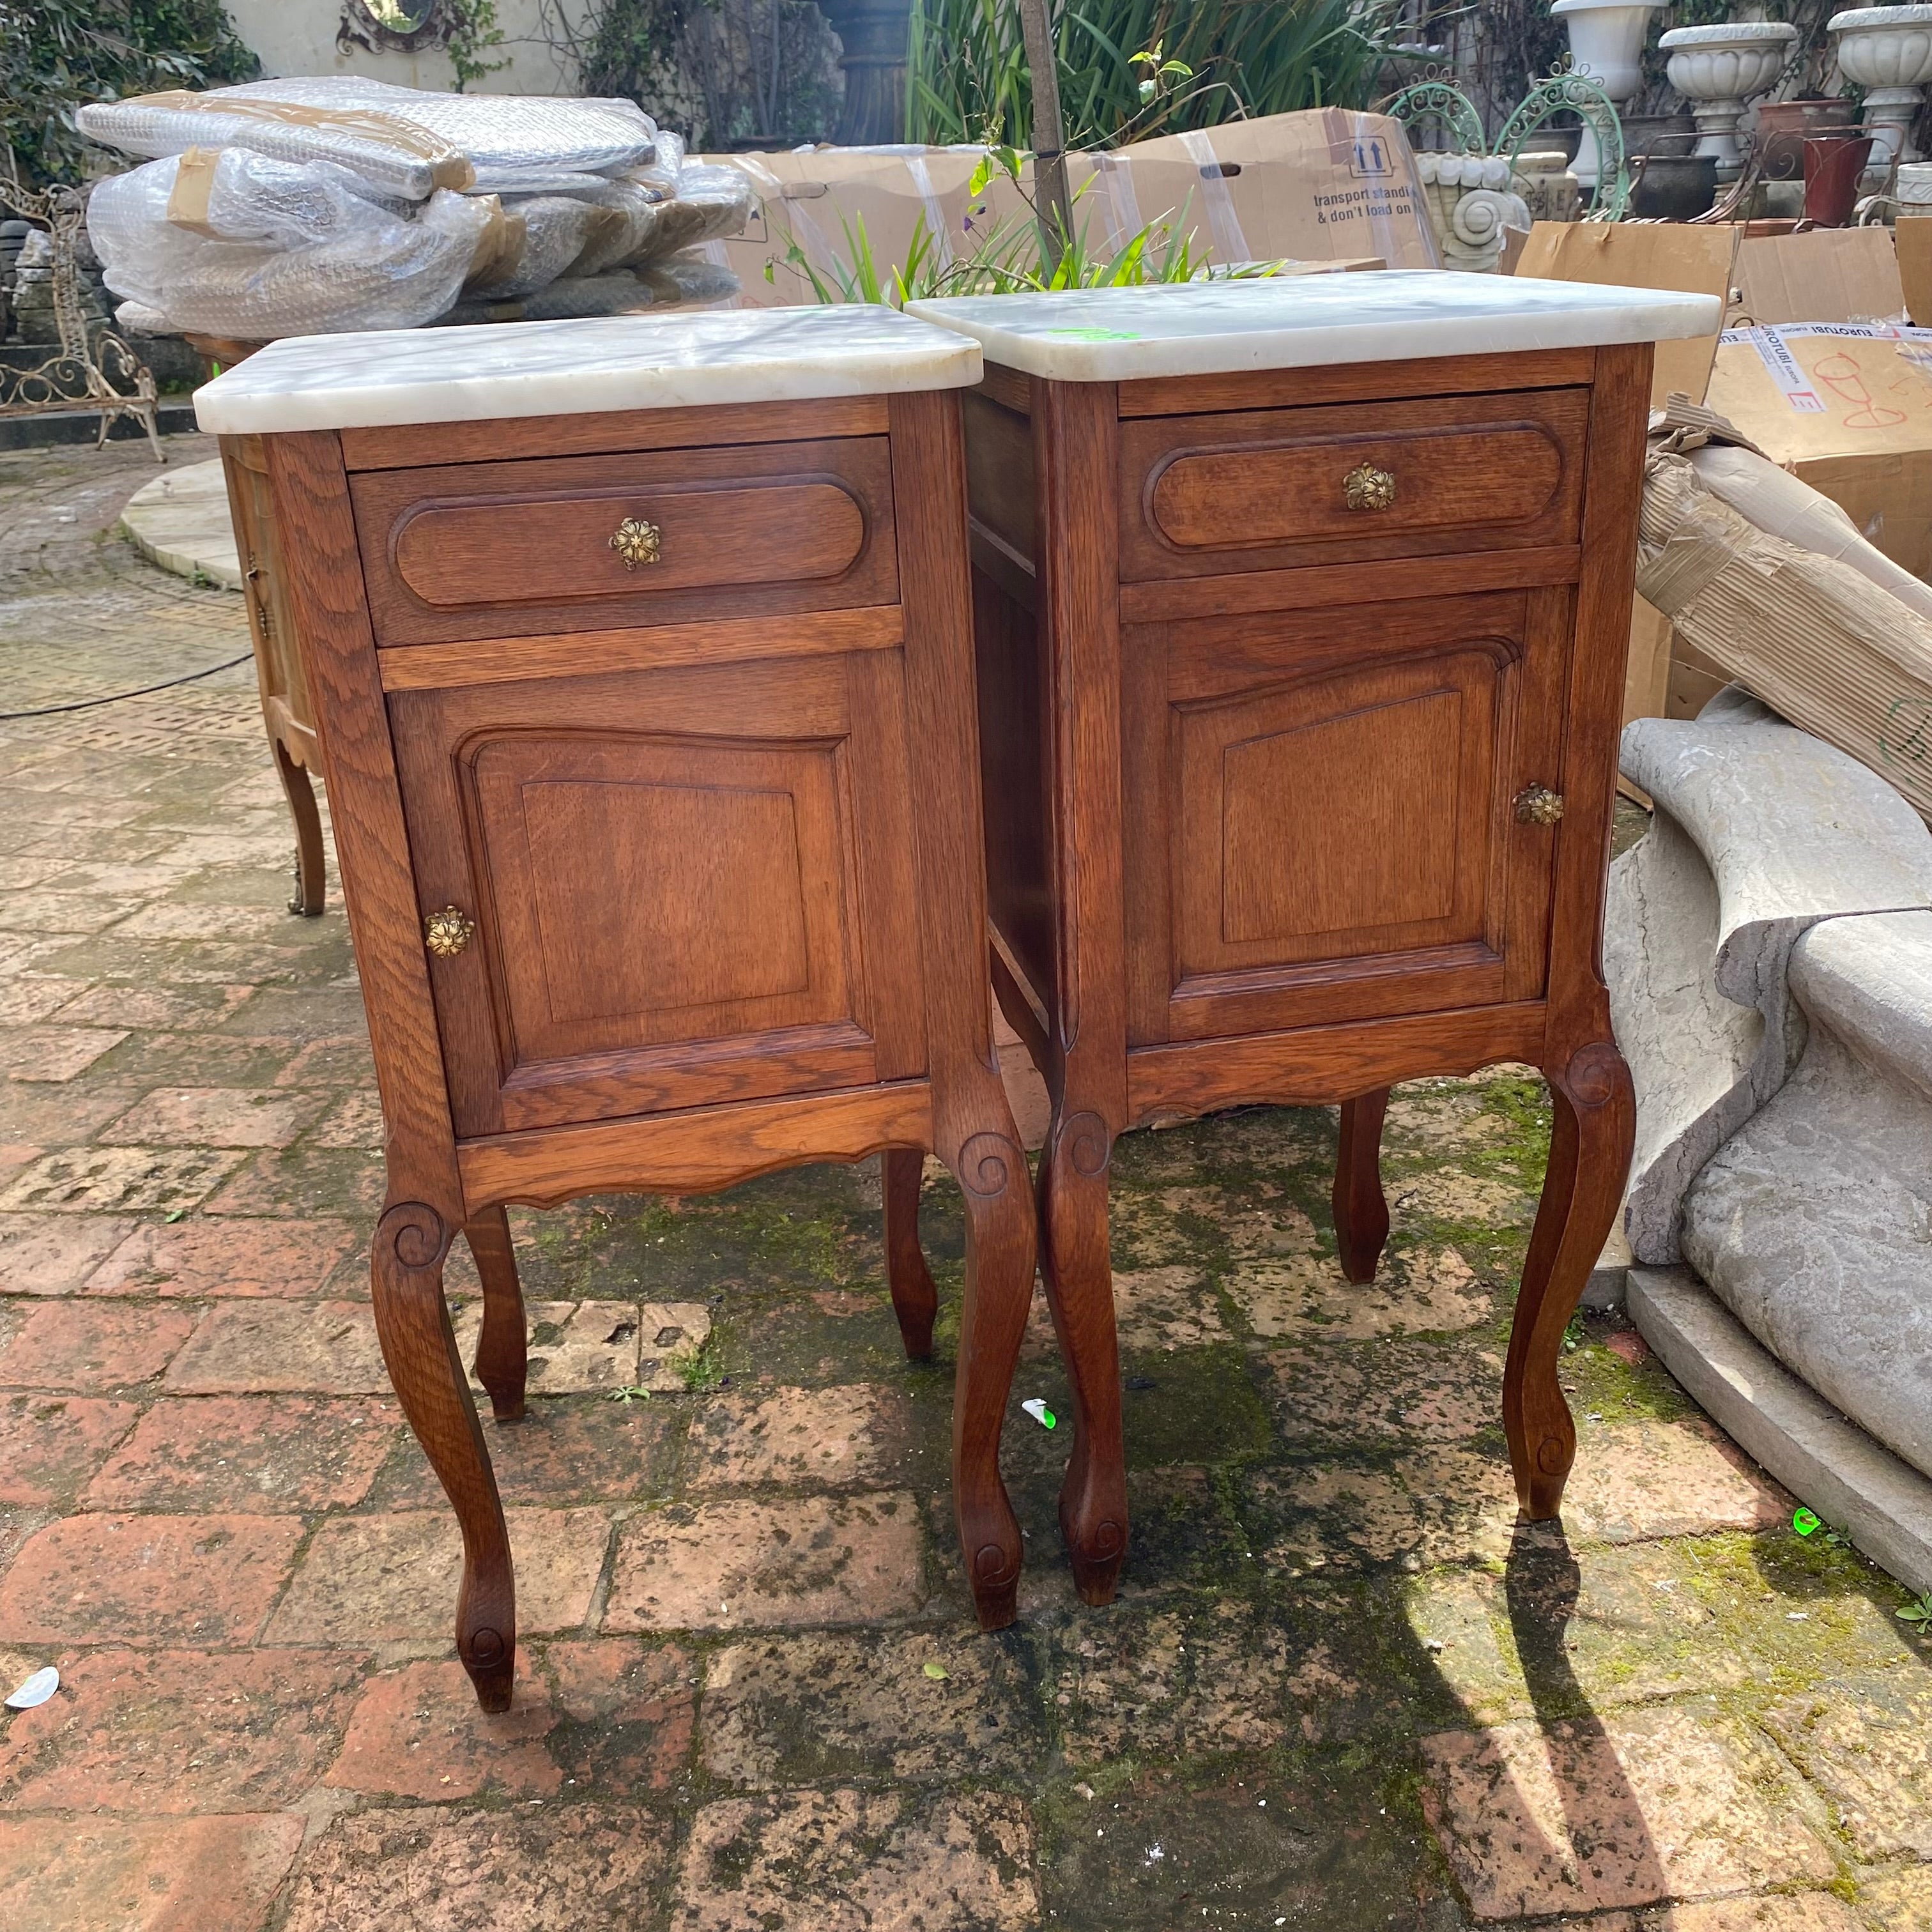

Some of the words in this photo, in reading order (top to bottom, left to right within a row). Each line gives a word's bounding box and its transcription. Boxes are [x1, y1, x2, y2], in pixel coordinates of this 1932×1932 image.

[1314, 188, 1370, 206] transport
[1318, 211, 1326, 224] &
[1331, 206, 1363, 222] don't
[1366, 203, 1392, 216] load
[1396, 204, 1411, 214] on
[1811, 326, 1873, 337] EUROTUBI
